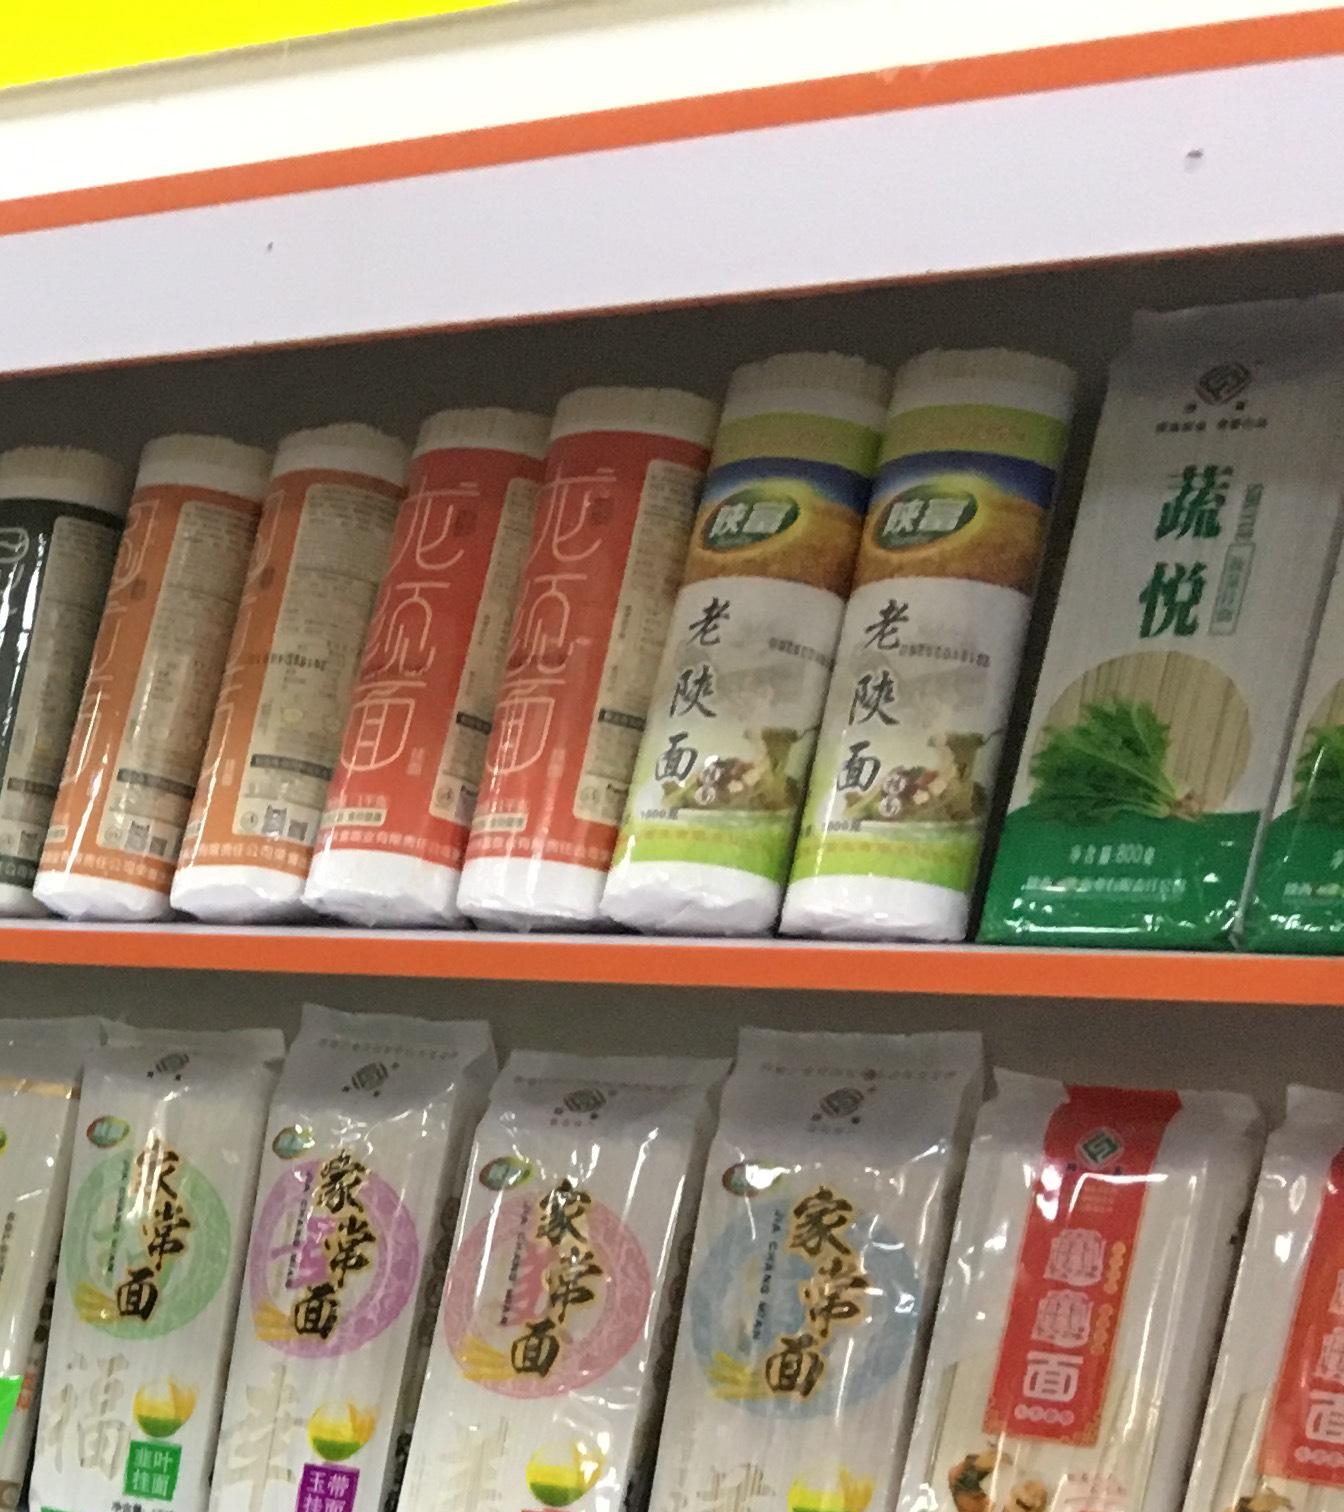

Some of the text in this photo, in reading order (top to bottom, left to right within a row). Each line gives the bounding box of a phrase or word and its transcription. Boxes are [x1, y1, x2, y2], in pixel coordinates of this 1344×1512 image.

[655, 597, 730, 783] 老陕面
[836, 599, 909, 793] 老陕面
[294, 1148, 377, 1340] 家常面
[510, 1177, 603, 1378] 家常面
[765, 1185, 870, 1397] 家常面
[308, 1471, 351, 1499] 玉带
